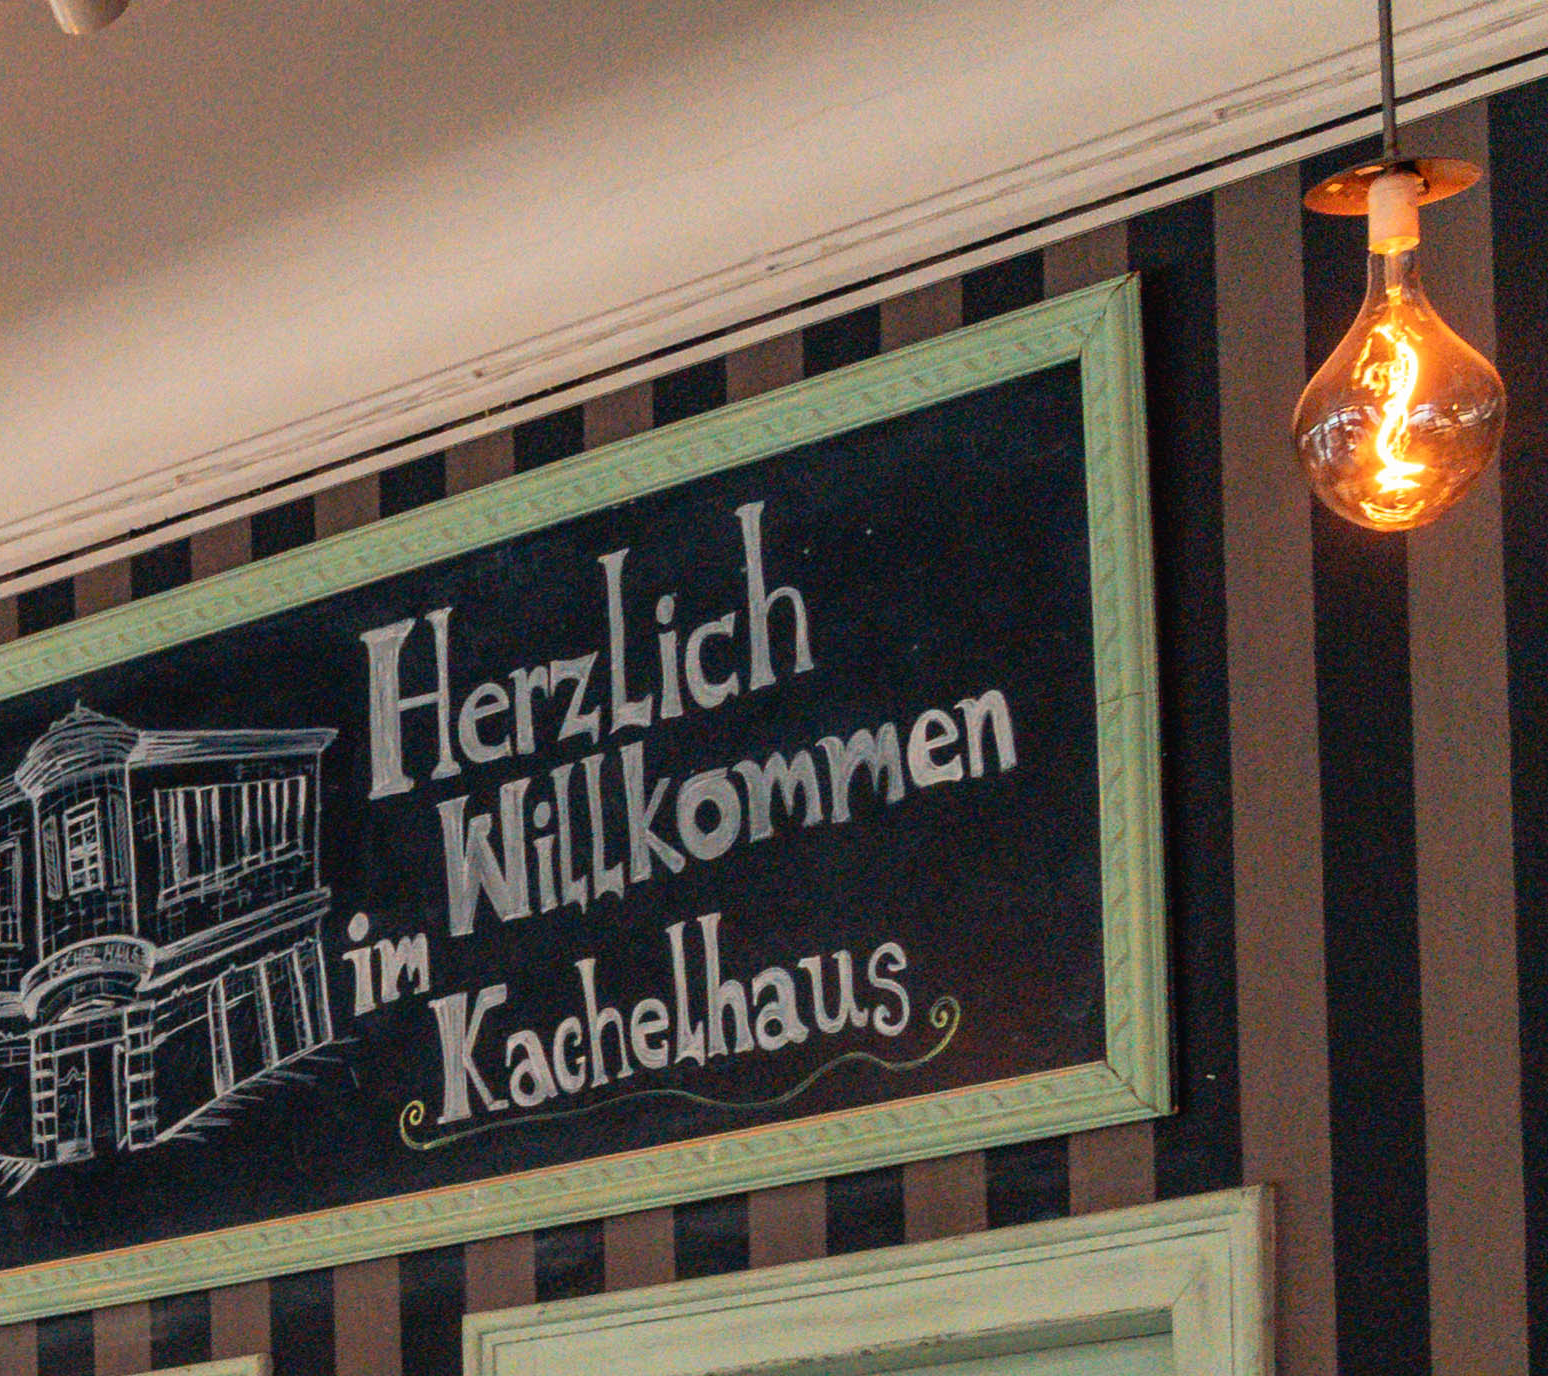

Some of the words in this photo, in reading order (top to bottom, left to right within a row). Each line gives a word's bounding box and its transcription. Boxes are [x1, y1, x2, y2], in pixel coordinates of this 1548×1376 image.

[434, 687, 1016, 937] Willkommen
[341, 911, 433, 1019] im
[427, 910, 912, 1127] Kachelhaus
